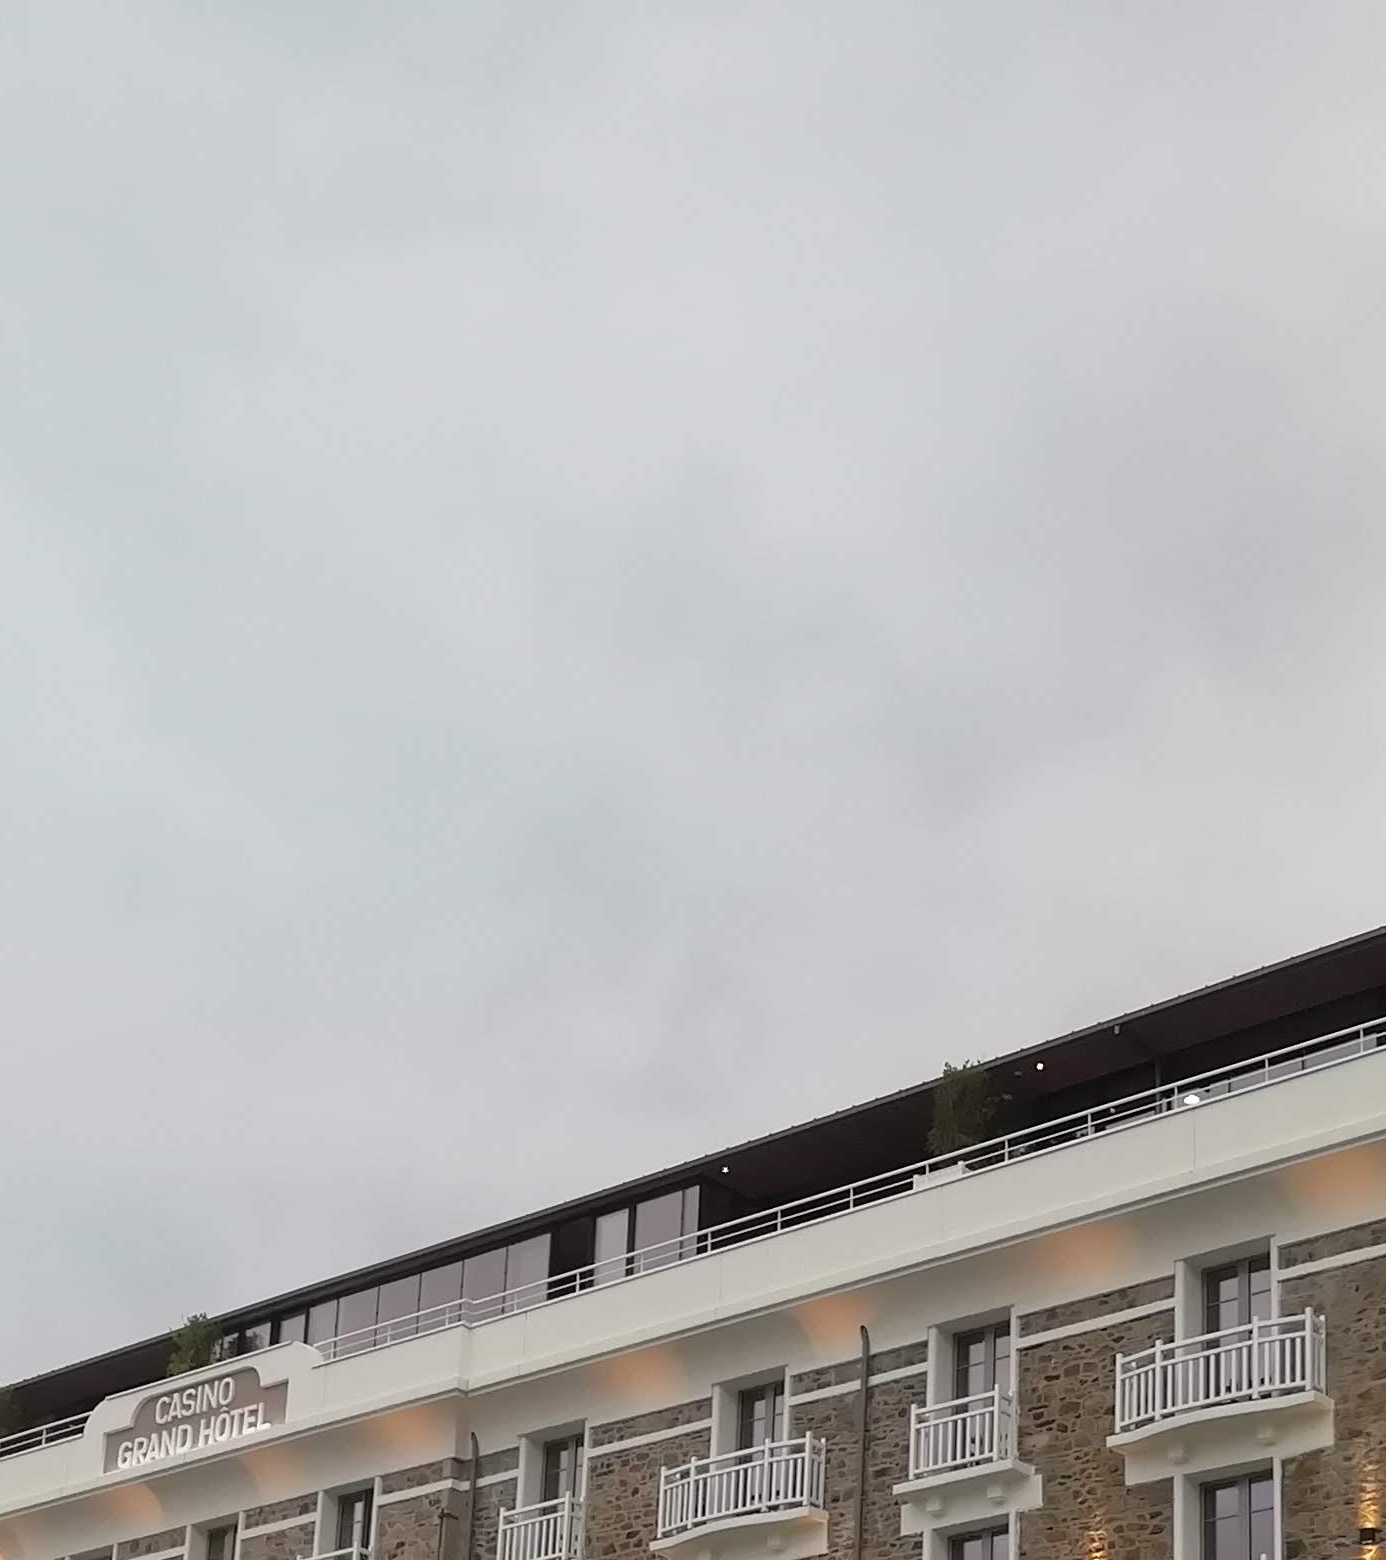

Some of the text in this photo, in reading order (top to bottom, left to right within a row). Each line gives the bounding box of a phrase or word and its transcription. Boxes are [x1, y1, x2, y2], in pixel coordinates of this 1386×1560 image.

[155, 1377, 236, 1425] CASINO
[117, 1401, 272, 1470] GRAND HÔTEL
